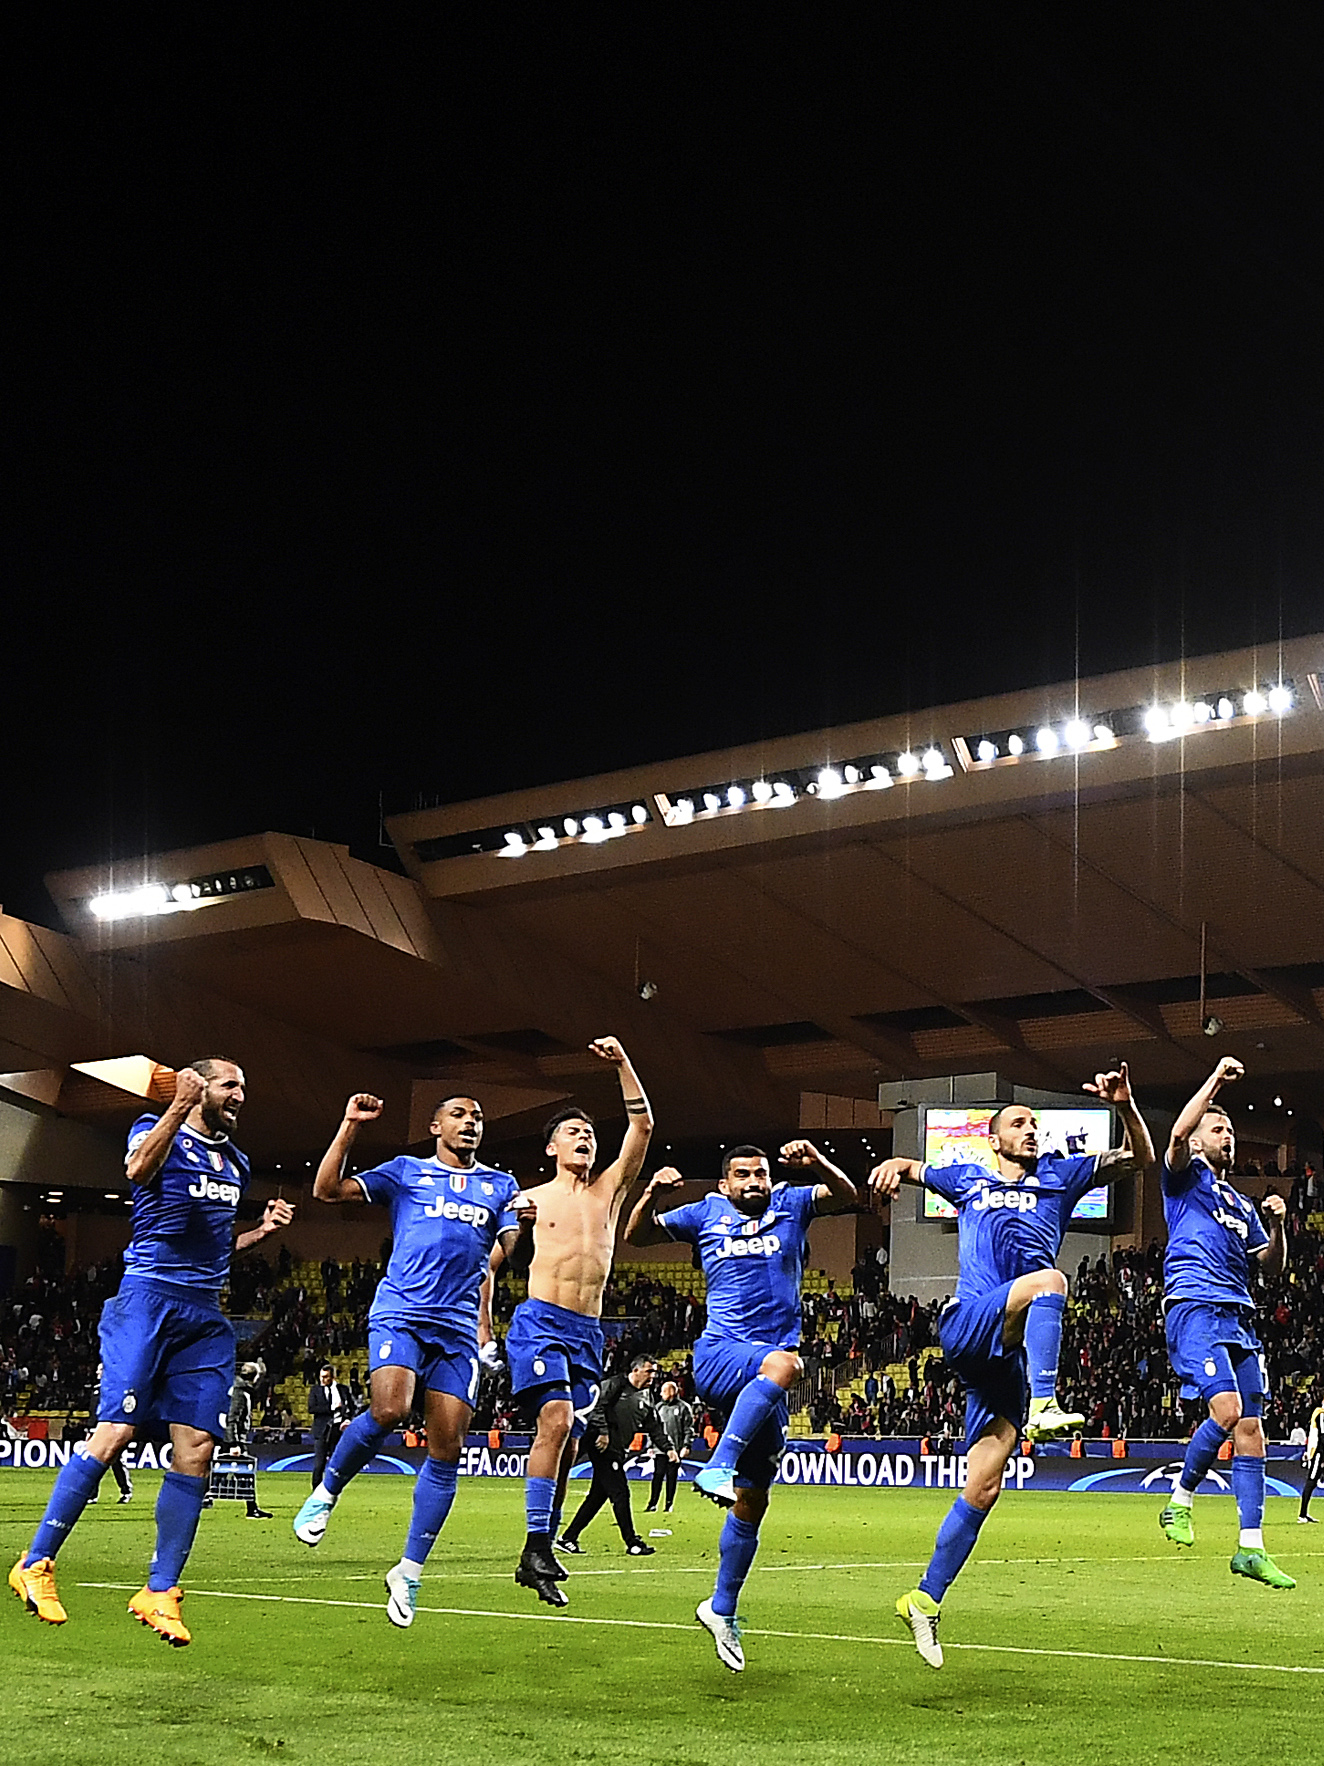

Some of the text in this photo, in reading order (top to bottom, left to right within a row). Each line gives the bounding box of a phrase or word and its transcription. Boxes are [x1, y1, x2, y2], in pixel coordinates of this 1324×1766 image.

[188, 1174, 240, 1207] Jeep
[971, 1186, 1038, 1213] Jeep
[424, 1195, 489, 1228] Jeep
[715, 1235, 781, 1258] Jeep
[457, 1447, 531, 1477] EFA.co
[774, 1451, 1035, 1490] OWNLOAD THE PP
